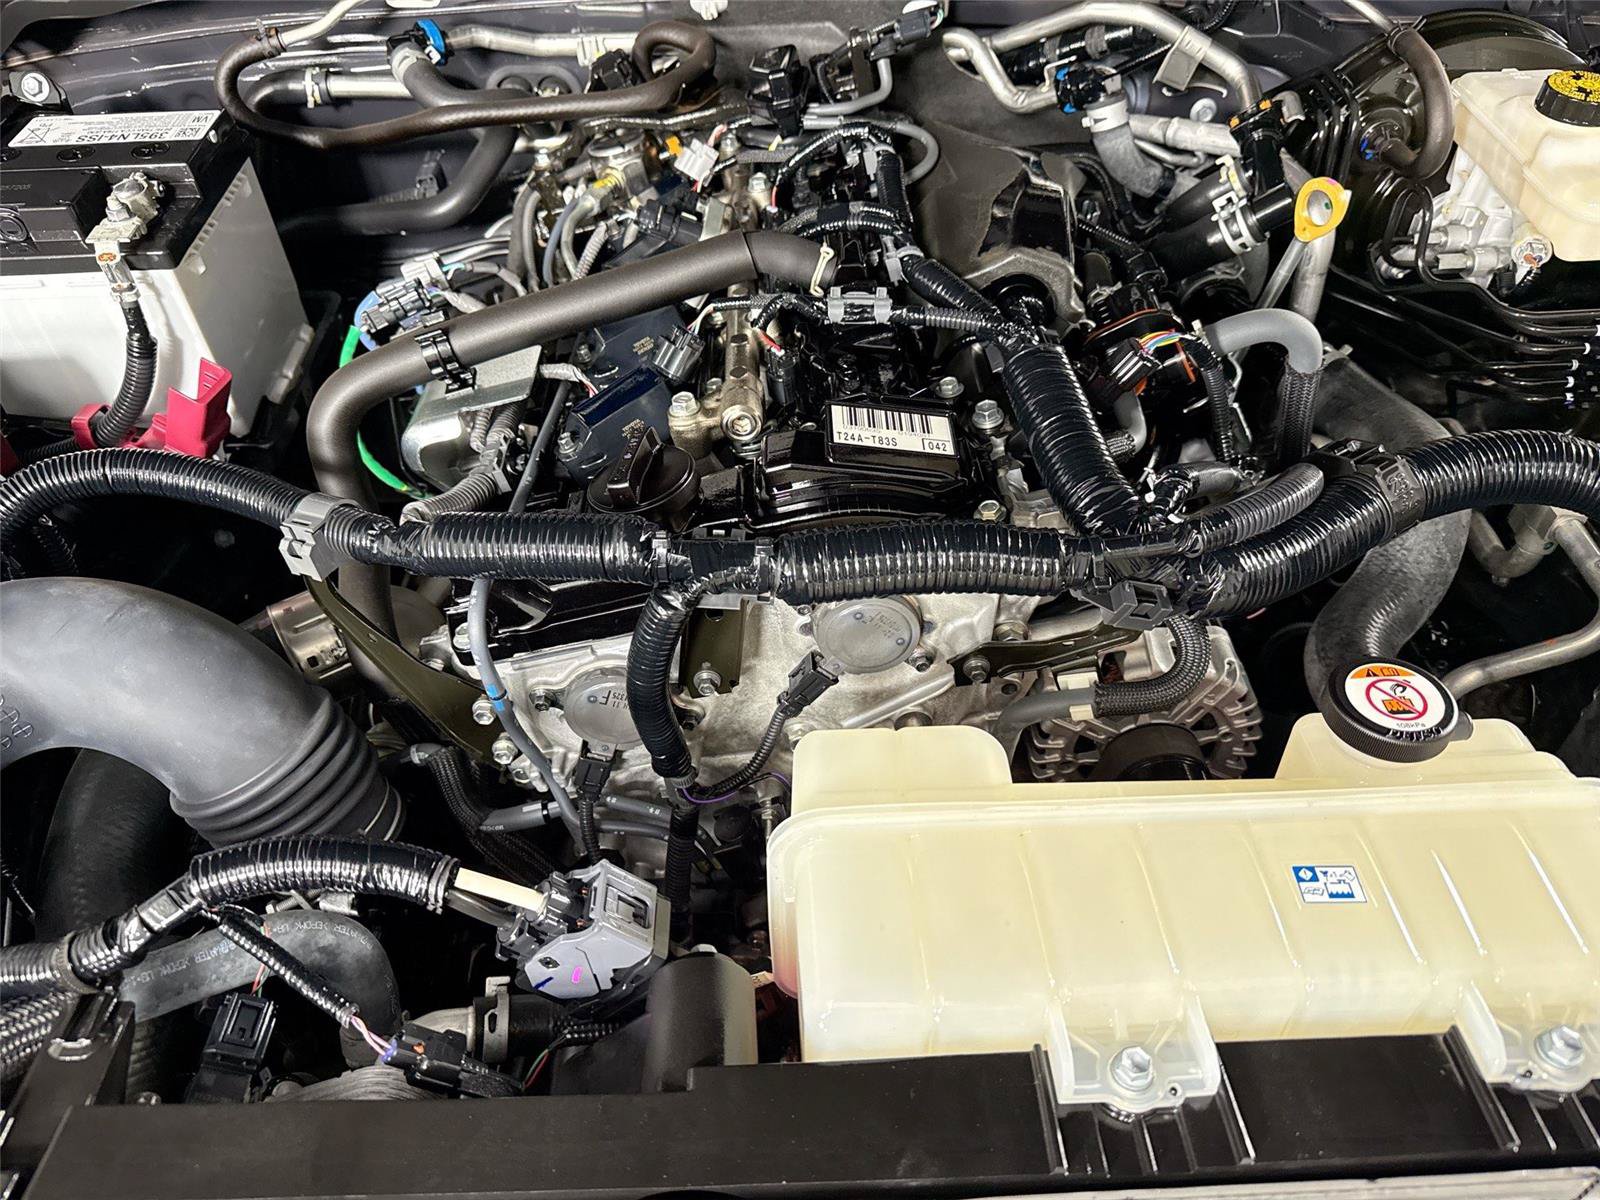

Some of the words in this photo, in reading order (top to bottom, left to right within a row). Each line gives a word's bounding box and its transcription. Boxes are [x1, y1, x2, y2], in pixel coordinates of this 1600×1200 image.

[76, 131, 170, 143] 395LN4-ISS
[837, 431, 898, 447] T24A-T83S
[928, 441, 948, 452] 042
